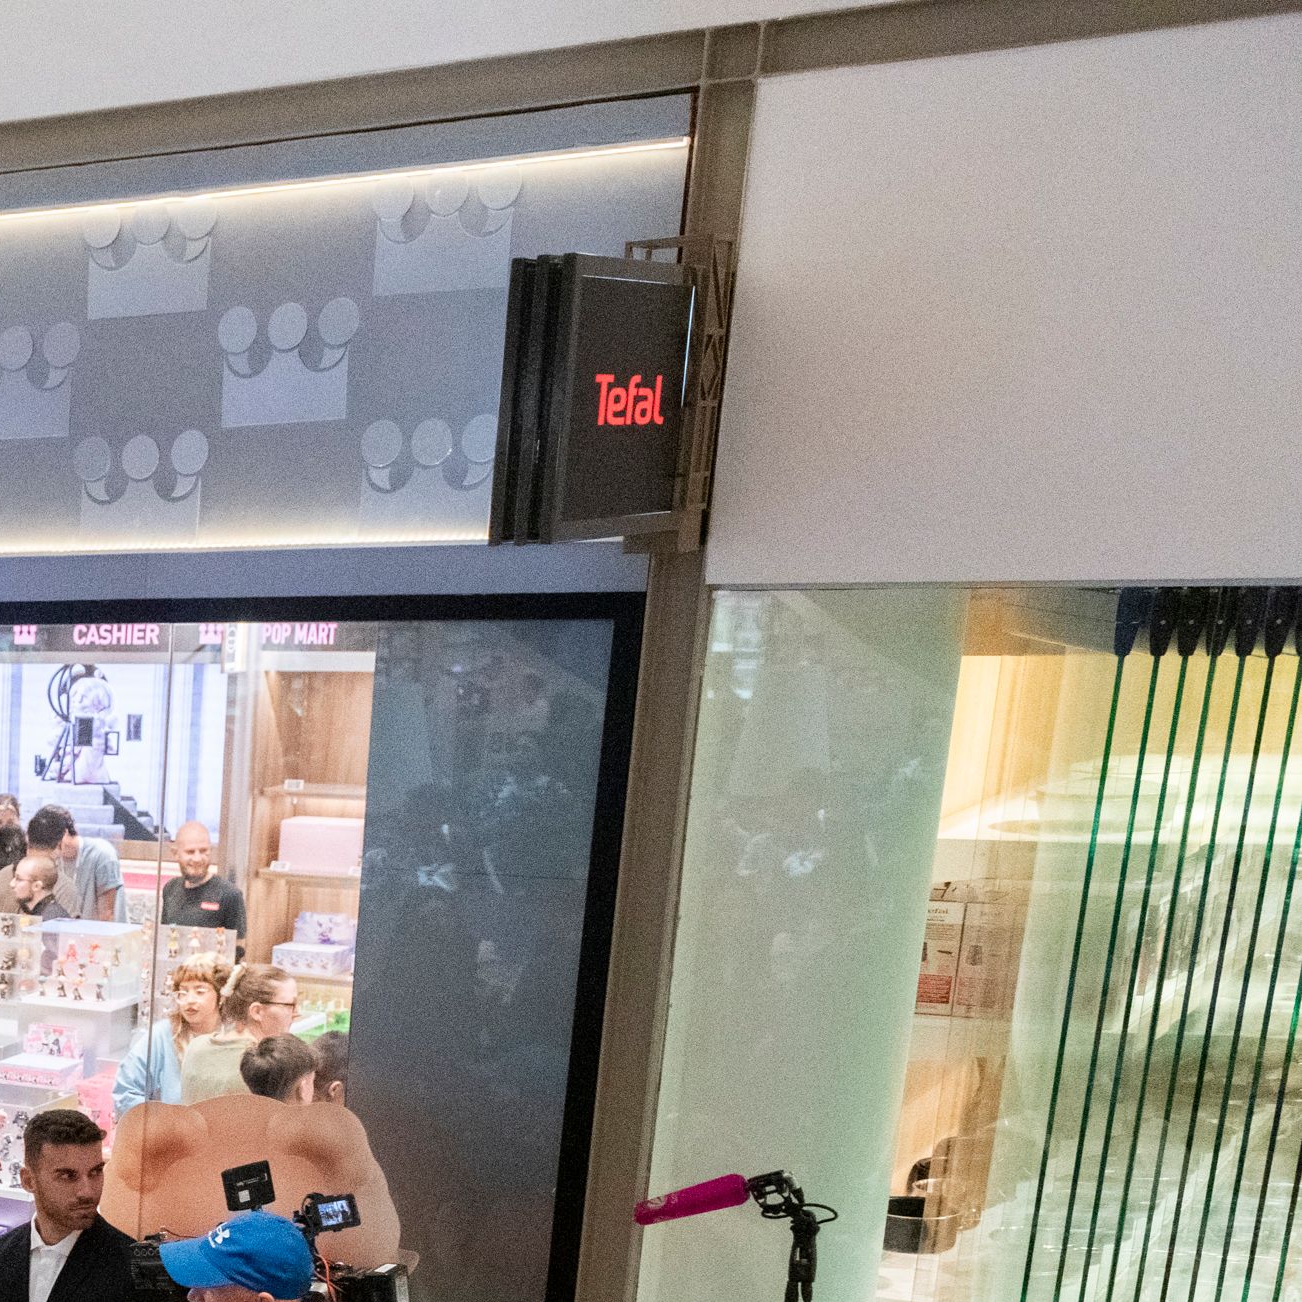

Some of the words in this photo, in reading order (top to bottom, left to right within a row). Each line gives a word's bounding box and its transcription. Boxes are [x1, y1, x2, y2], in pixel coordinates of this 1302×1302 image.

[595, 373, 664, 426] Tefal
[73, 624, 159, 646] CASHIER
[262, 624, 291, 645] POP
[294, 623, 337, 645] MART
